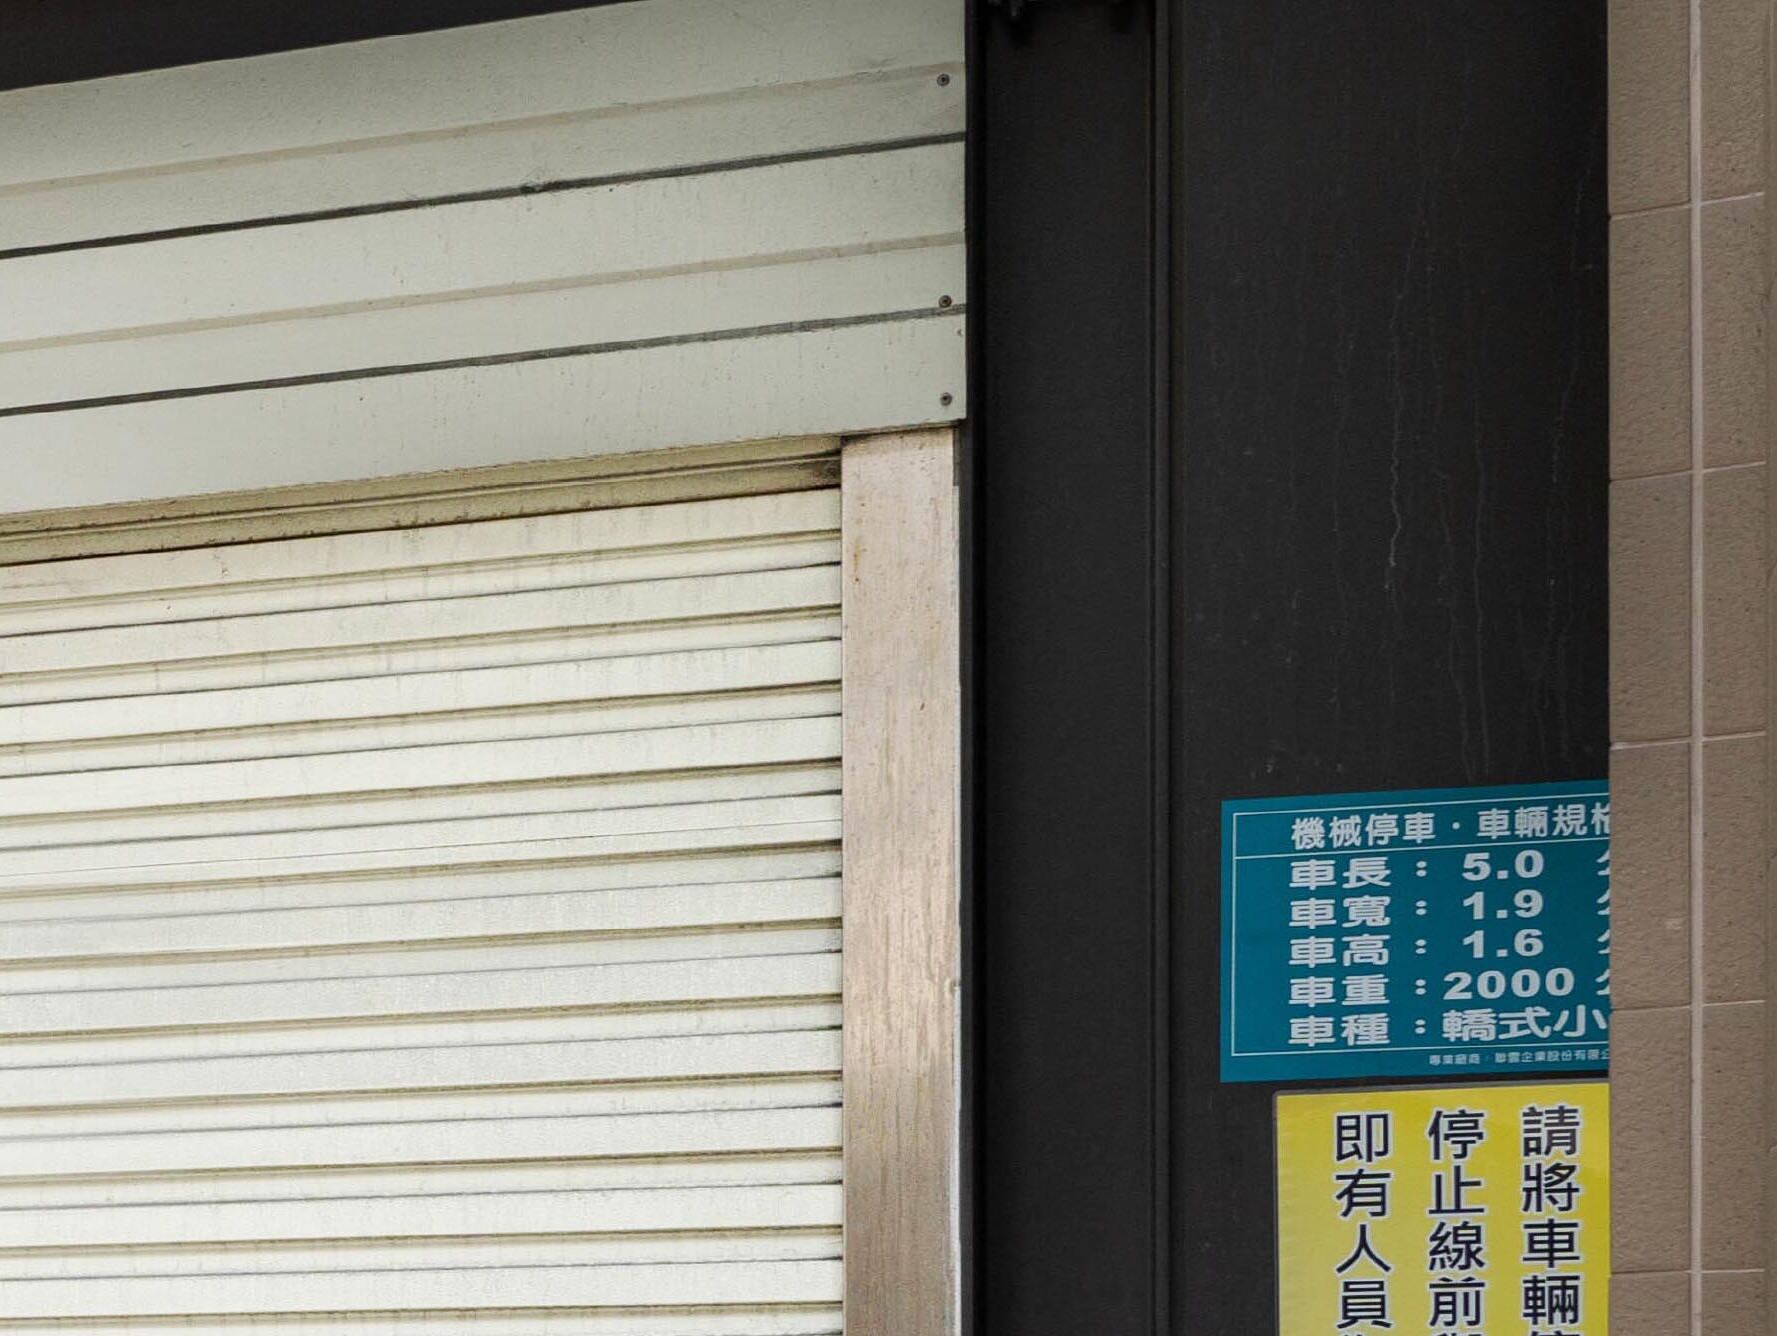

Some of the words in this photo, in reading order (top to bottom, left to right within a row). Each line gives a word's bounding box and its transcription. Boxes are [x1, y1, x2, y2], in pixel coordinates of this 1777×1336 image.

[1461, 850, 1545, 881] 5.0
[1462, 889, 1545, 921] 1.9
[1462, 929, 1545, 959] 1.6
